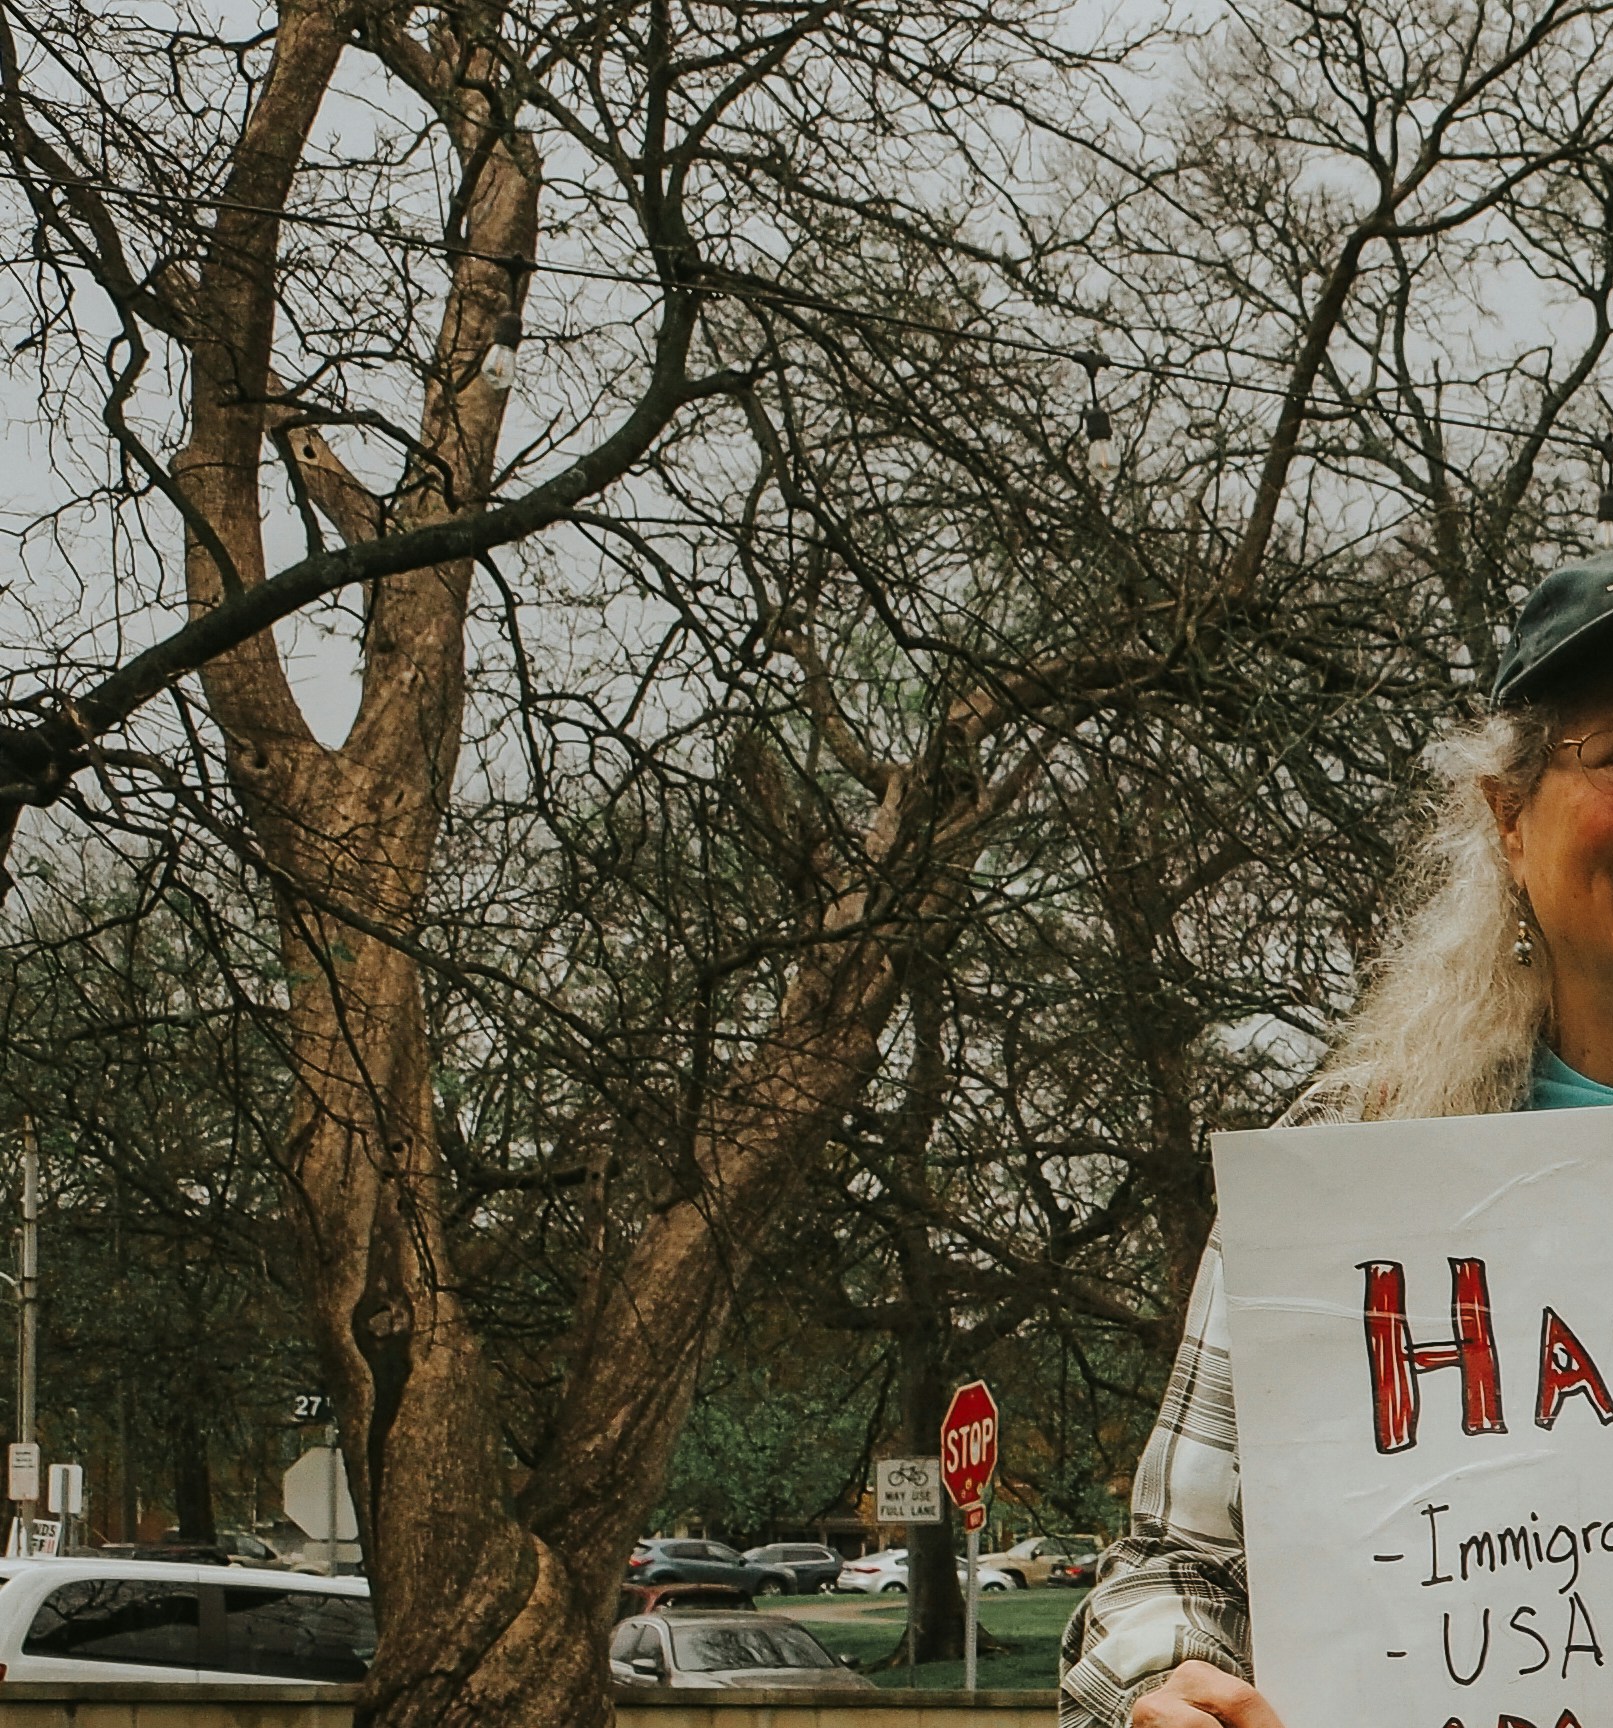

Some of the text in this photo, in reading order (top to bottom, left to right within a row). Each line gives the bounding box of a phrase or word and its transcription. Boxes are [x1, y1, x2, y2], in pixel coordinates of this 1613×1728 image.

[947, 1417, 993, 1473] STOP
[881, 1505, 936, 1516] FULL LANE
